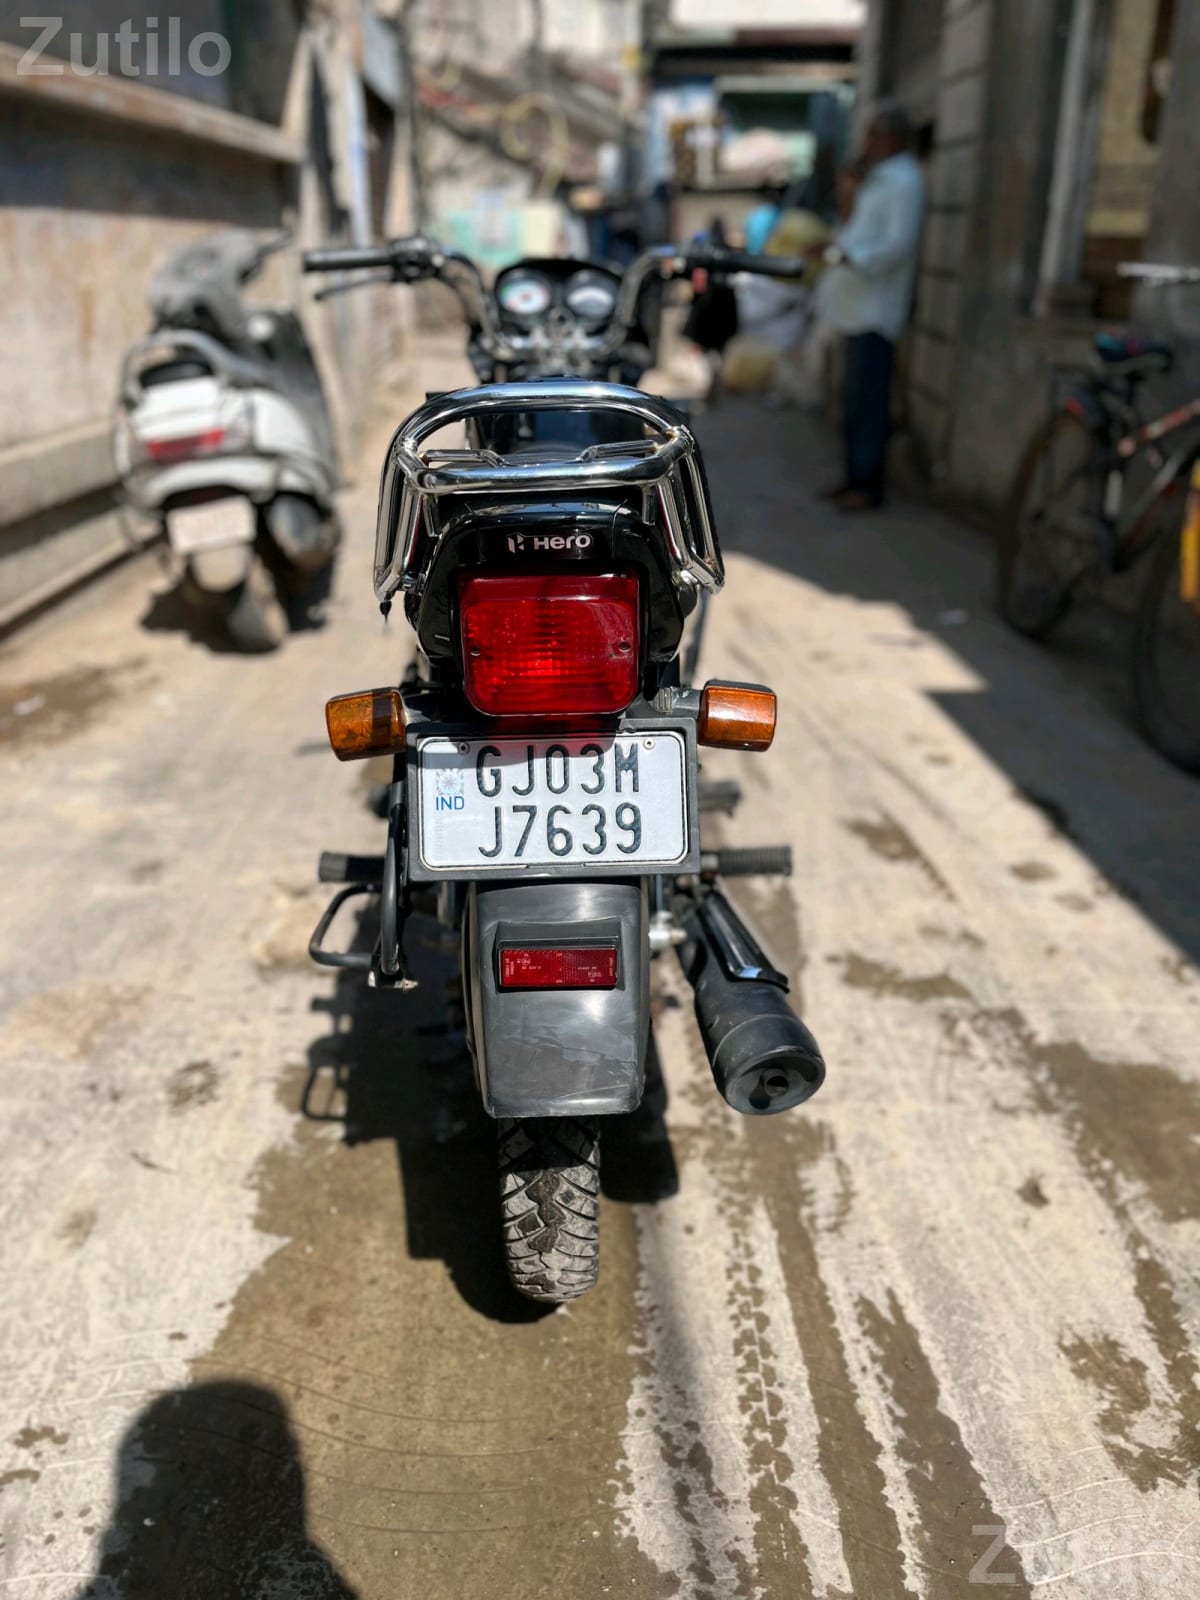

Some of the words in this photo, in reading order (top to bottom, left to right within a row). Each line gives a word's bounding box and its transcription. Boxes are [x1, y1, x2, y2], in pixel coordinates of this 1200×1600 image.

[533, 534, 591, 550] Hero
[476, 743, 640, 797] GJ03M
[435, 796, 465, 811] IND
[478, 802, 642, 858] J7639
